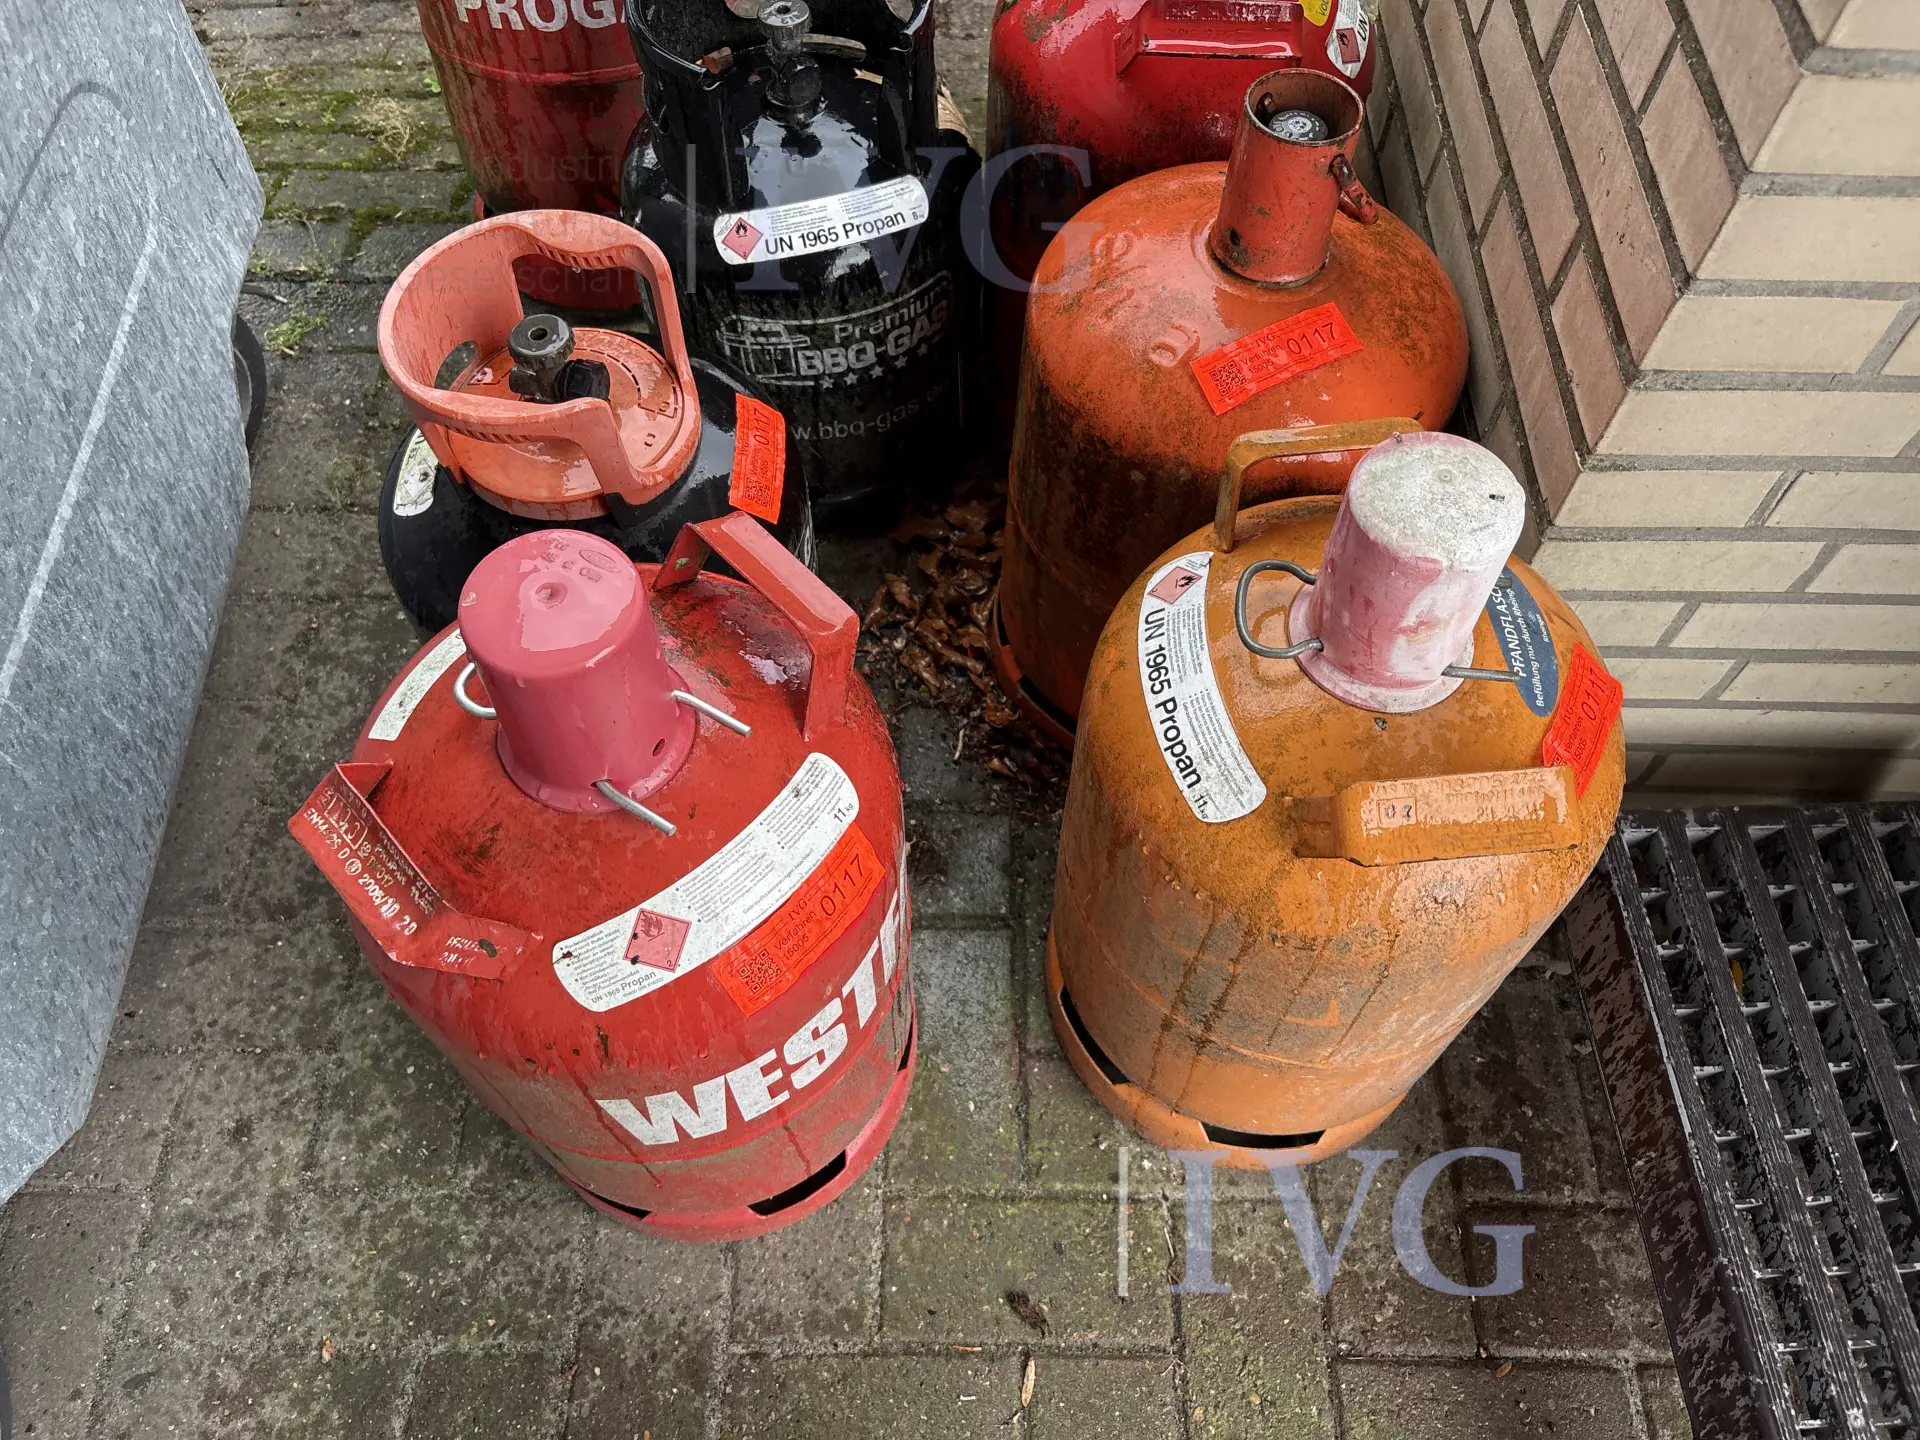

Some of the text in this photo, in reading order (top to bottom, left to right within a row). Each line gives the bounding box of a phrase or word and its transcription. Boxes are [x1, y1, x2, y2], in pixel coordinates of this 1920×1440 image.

[455, 0, 627, 32] PROG
[1357, 13, 1368, 41] UN
[765, 235, 794, 255] UN
[798, 228, 840, 249] 1965
[842, 211, 907, 241] Propan
[911, 211, 919, 221] 8
[797, 299, 949, 376] BBQ-GAS
[1240, 321, 1338, 366] Verfahren 0117
[1255, 332, 1276, 349] IVG
[1248, 359, 1274, 375] 15005
[753, 407, 770, 446] 0117
[1144, 607, 1166, 642] UN
[1491, 571, 1527, 677] PFANDFLASC
[1519, 617, 1532, 642] durch
[1526, 642, 1537, 659] nur
[1145, 643, 1172, 695] 1965
[1530, 659, 1545, 707] Befüllung
[1155, 696, 1202, 790] Propan
[833, 807, 847, 824] 11
[845, 802, 855, 813] kg
[1194, 793, 1209, 810] 11
[773, 910, 817, 952] Verfahren
[819, 853, 865, 917] 0117
[788, 897, 808, 921] IVG
[666, 959, 674, 967] 2
[782, 933, 810, 961] 15005
[591, 993, 603, 1004] UN
[620, 970, 657, 991] Propan
